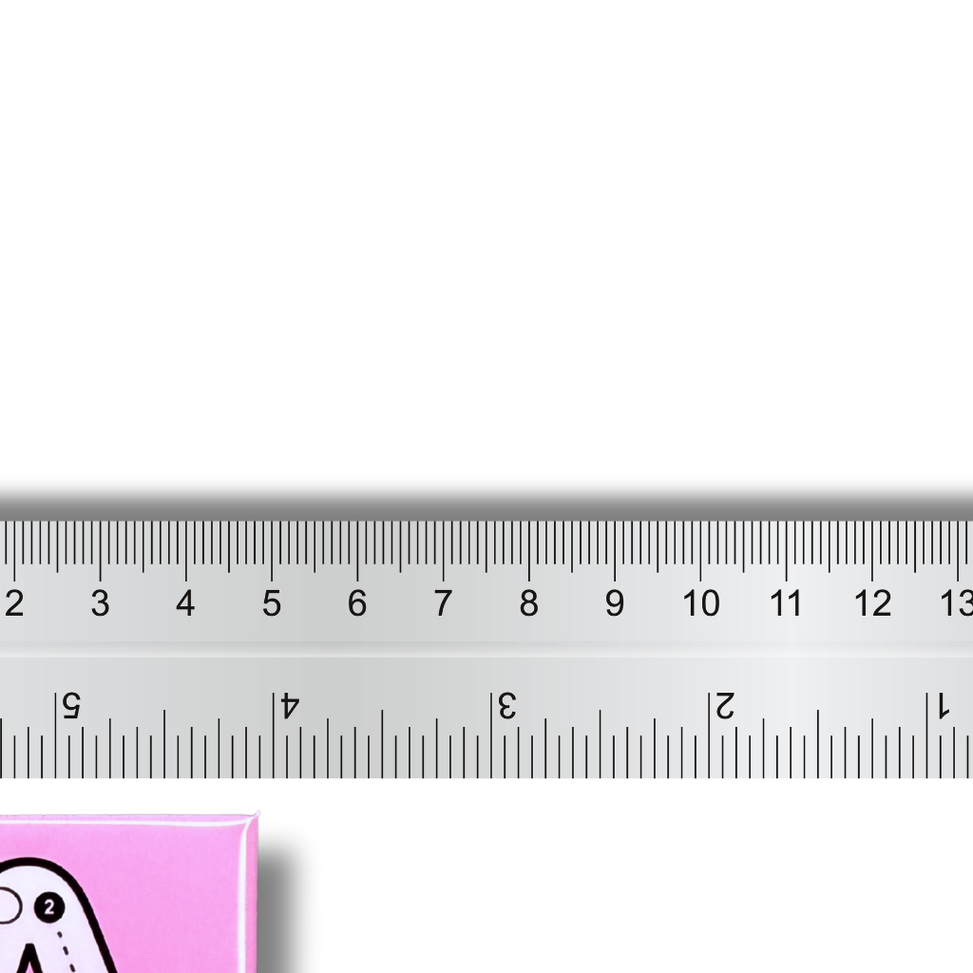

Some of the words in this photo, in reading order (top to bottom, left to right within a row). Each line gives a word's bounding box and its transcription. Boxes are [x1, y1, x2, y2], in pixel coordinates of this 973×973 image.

[5, 588, 24, 617] 2
[91, 588, 110, 617] 3
[176, 588, 196, 617] 4
[262, 588, 281, 617] 5
[348, 588, 367, 617] 6
[434, 588, 453, 617] 7
[520, 588, 539, 617] 8
[605, 588, 624, 617] 9
[683, 588, 720, 617] 10
[770, 588, 800, 617] 11
[855, 588, 891, 617] 12
[941, 588, 973, 617] 13
[62, 691, 81, 720] 5
[280, 691, 300, 720] 4
[498, 691, 517, 720] 3
[716, 691, 735, 720] 2
[939, 691, 950, 720] 1
[44, 899, 55, 915] 2
